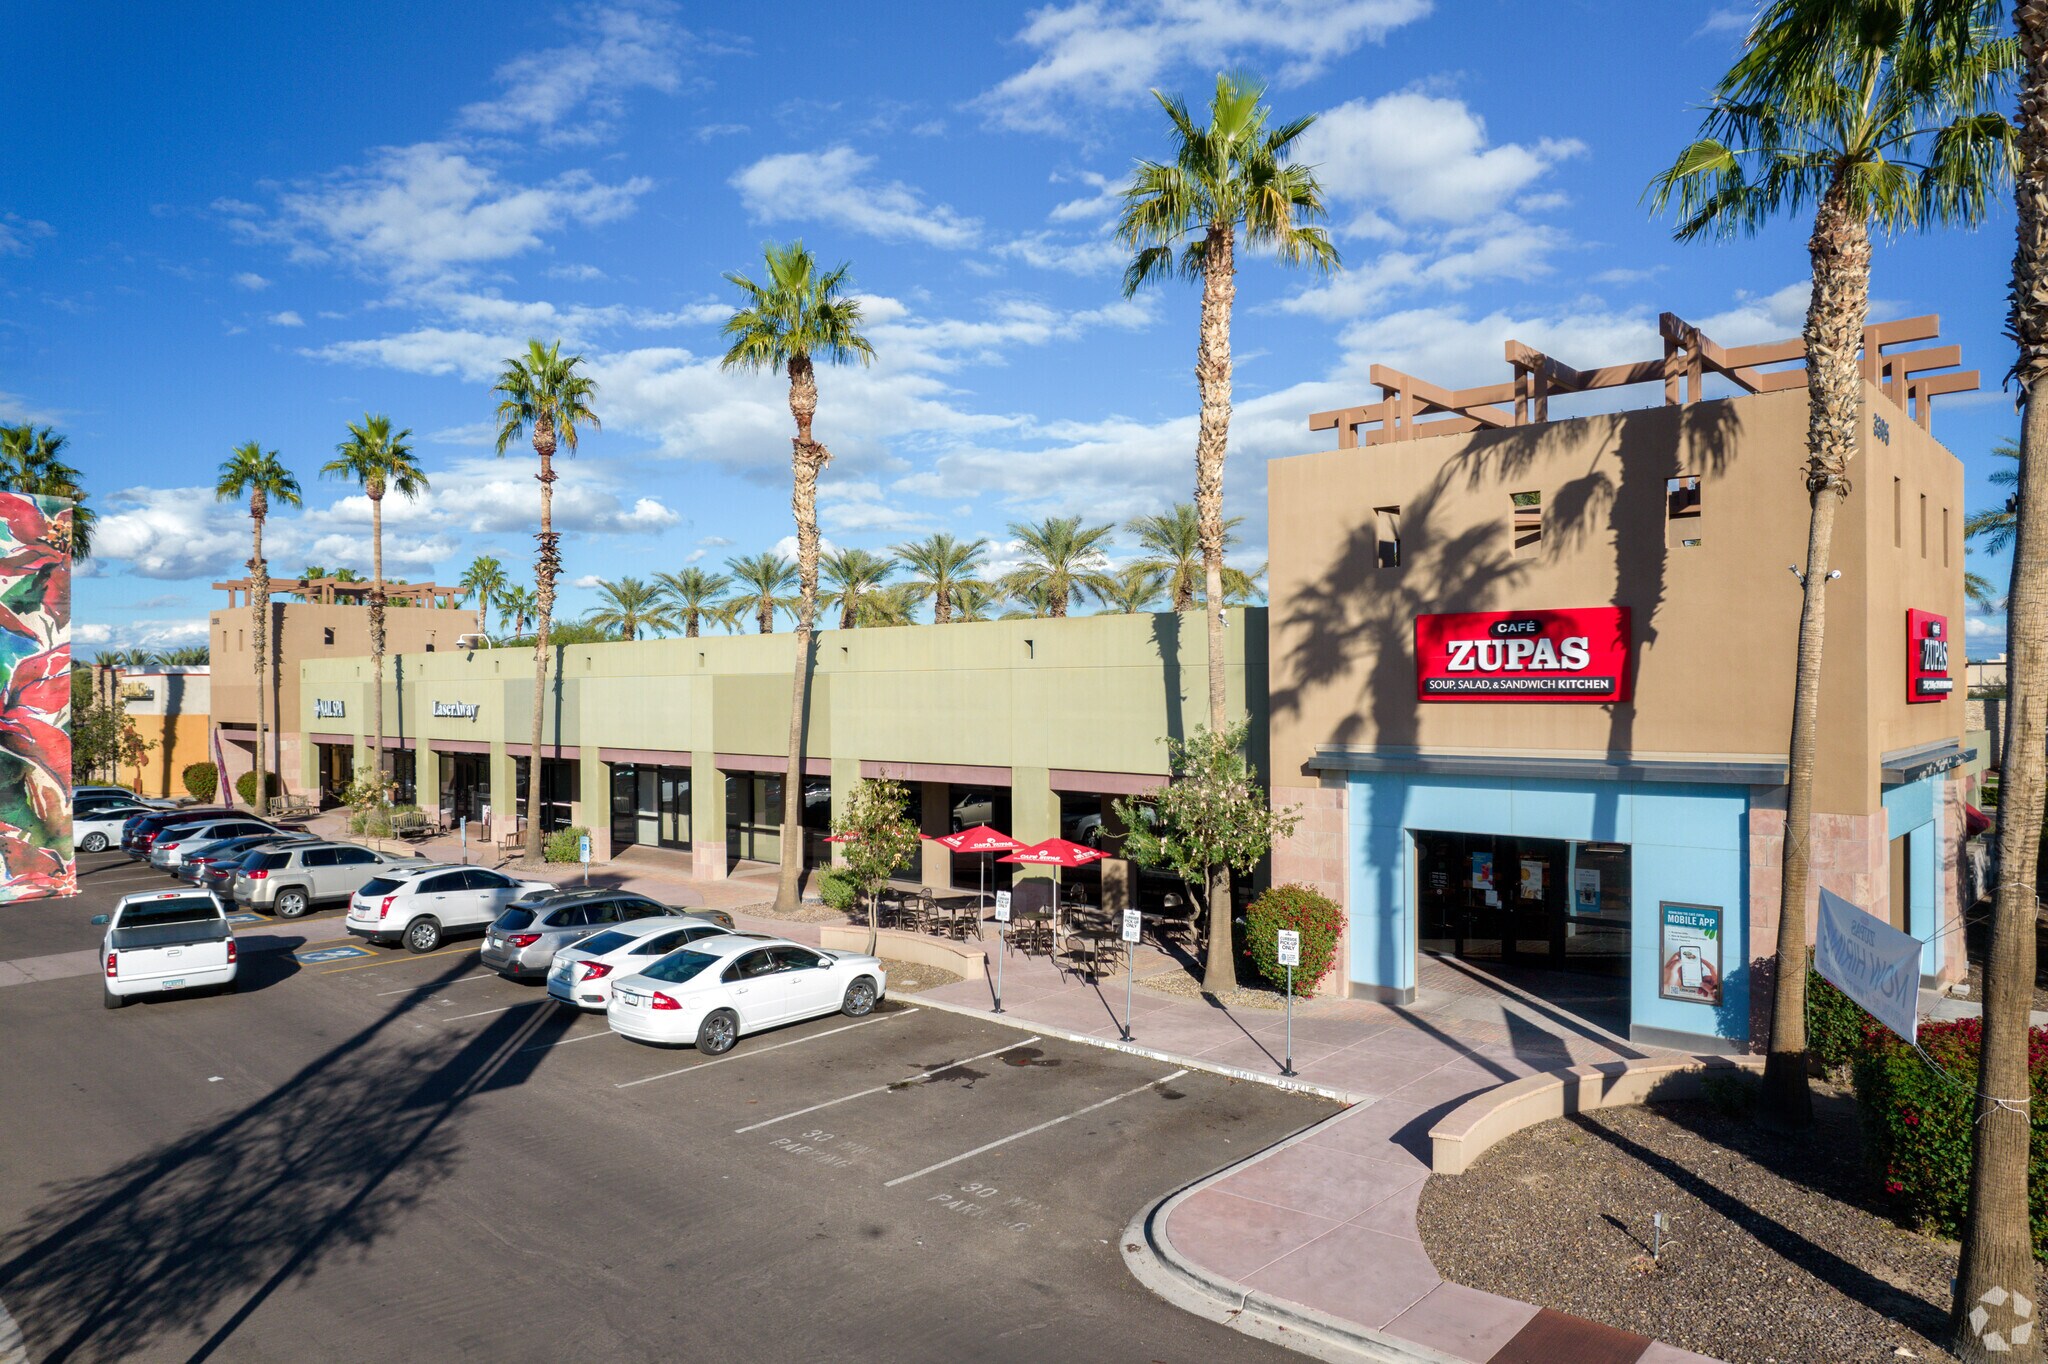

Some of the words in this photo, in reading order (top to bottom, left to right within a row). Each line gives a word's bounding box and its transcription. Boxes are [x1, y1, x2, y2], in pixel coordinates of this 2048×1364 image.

[1497, 620, 1536, 634] CAFÉ
[1447, 637, 1591, 671] ZUPAS
[1924, 638, 1948, 672] ZUPAS
[1429, 679, 1457, 691] SOUP,
[1458, 680, 1492, 691] SALAD,
[1493, 681, 1500, 690] &
[1500, 679, 1556, 690] SANDWICH
[1558, 679, 1610, 690] KITCHEN
[333, 700, 345, 718] SPA
[432, 700, 478, 722] LaserAway
[1667, 914, 1697, 926] MOBILE
[1698, 917, 1716, 927] APP
[802, 1129, 835, 1142] 30
[961, 1183, 998, 1198] 30
[926, 1193, 1032, 1232] PARKG
